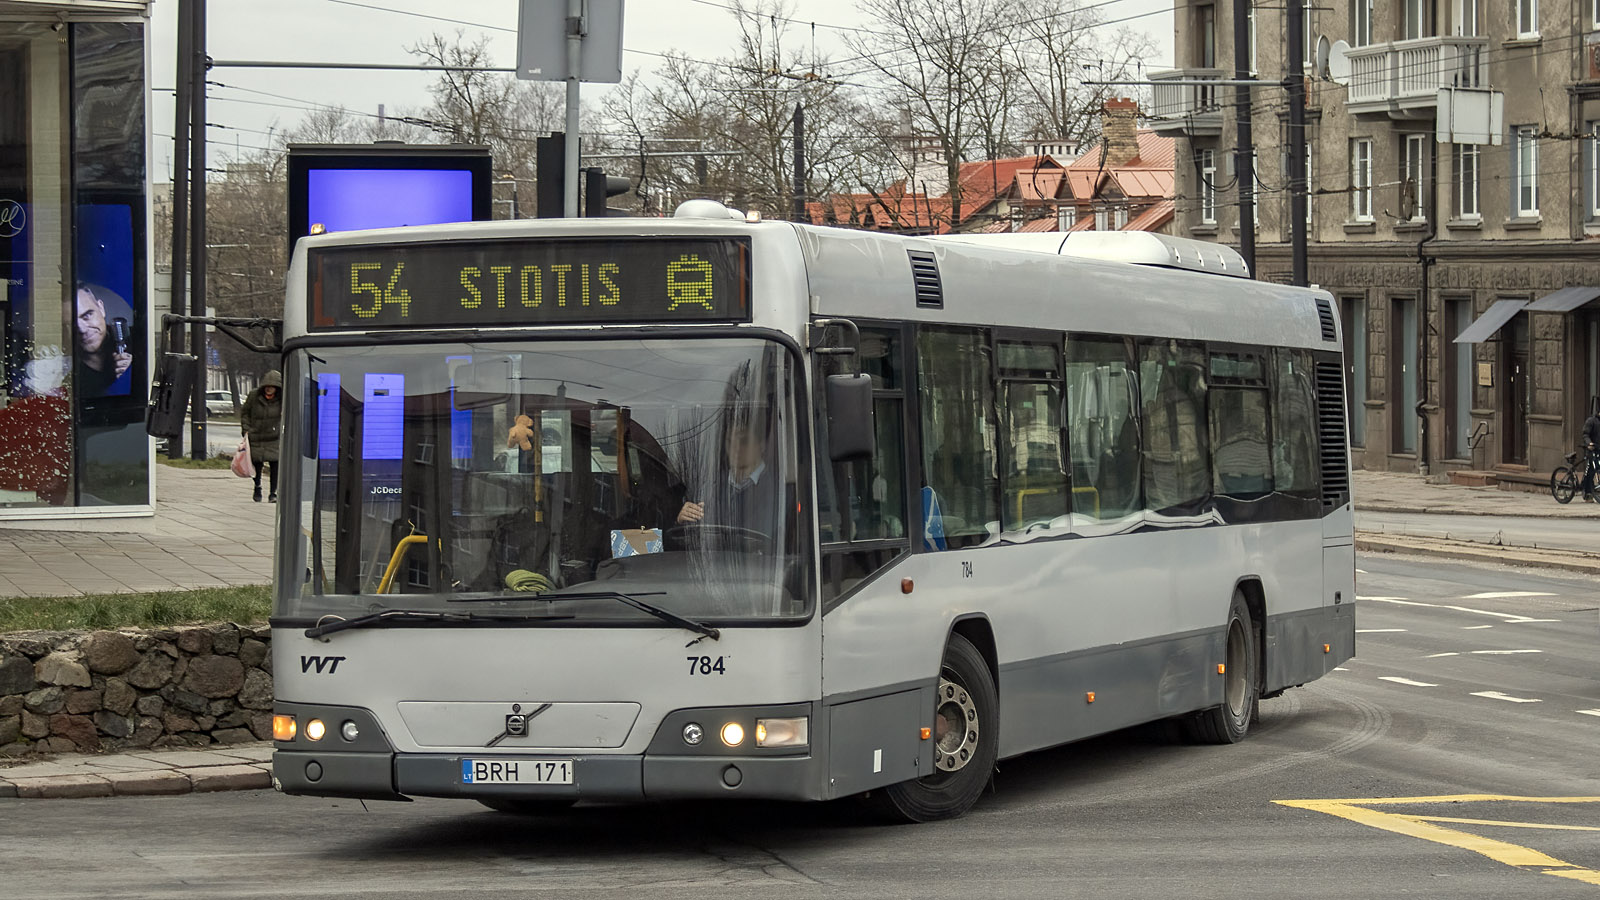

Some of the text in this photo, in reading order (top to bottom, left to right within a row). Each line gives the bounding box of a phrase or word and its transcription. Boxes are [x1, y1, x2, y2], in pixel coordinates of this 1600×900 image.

[351, 262, 621, 318] 54 STOTIS
[961, 561, 973, 579] 784
[300, 655, 347, 674] VVT
[686, 655, 726, 676] 784
[475, 762, 520, 782] BRH
[535, 762, 567, 782] 171
